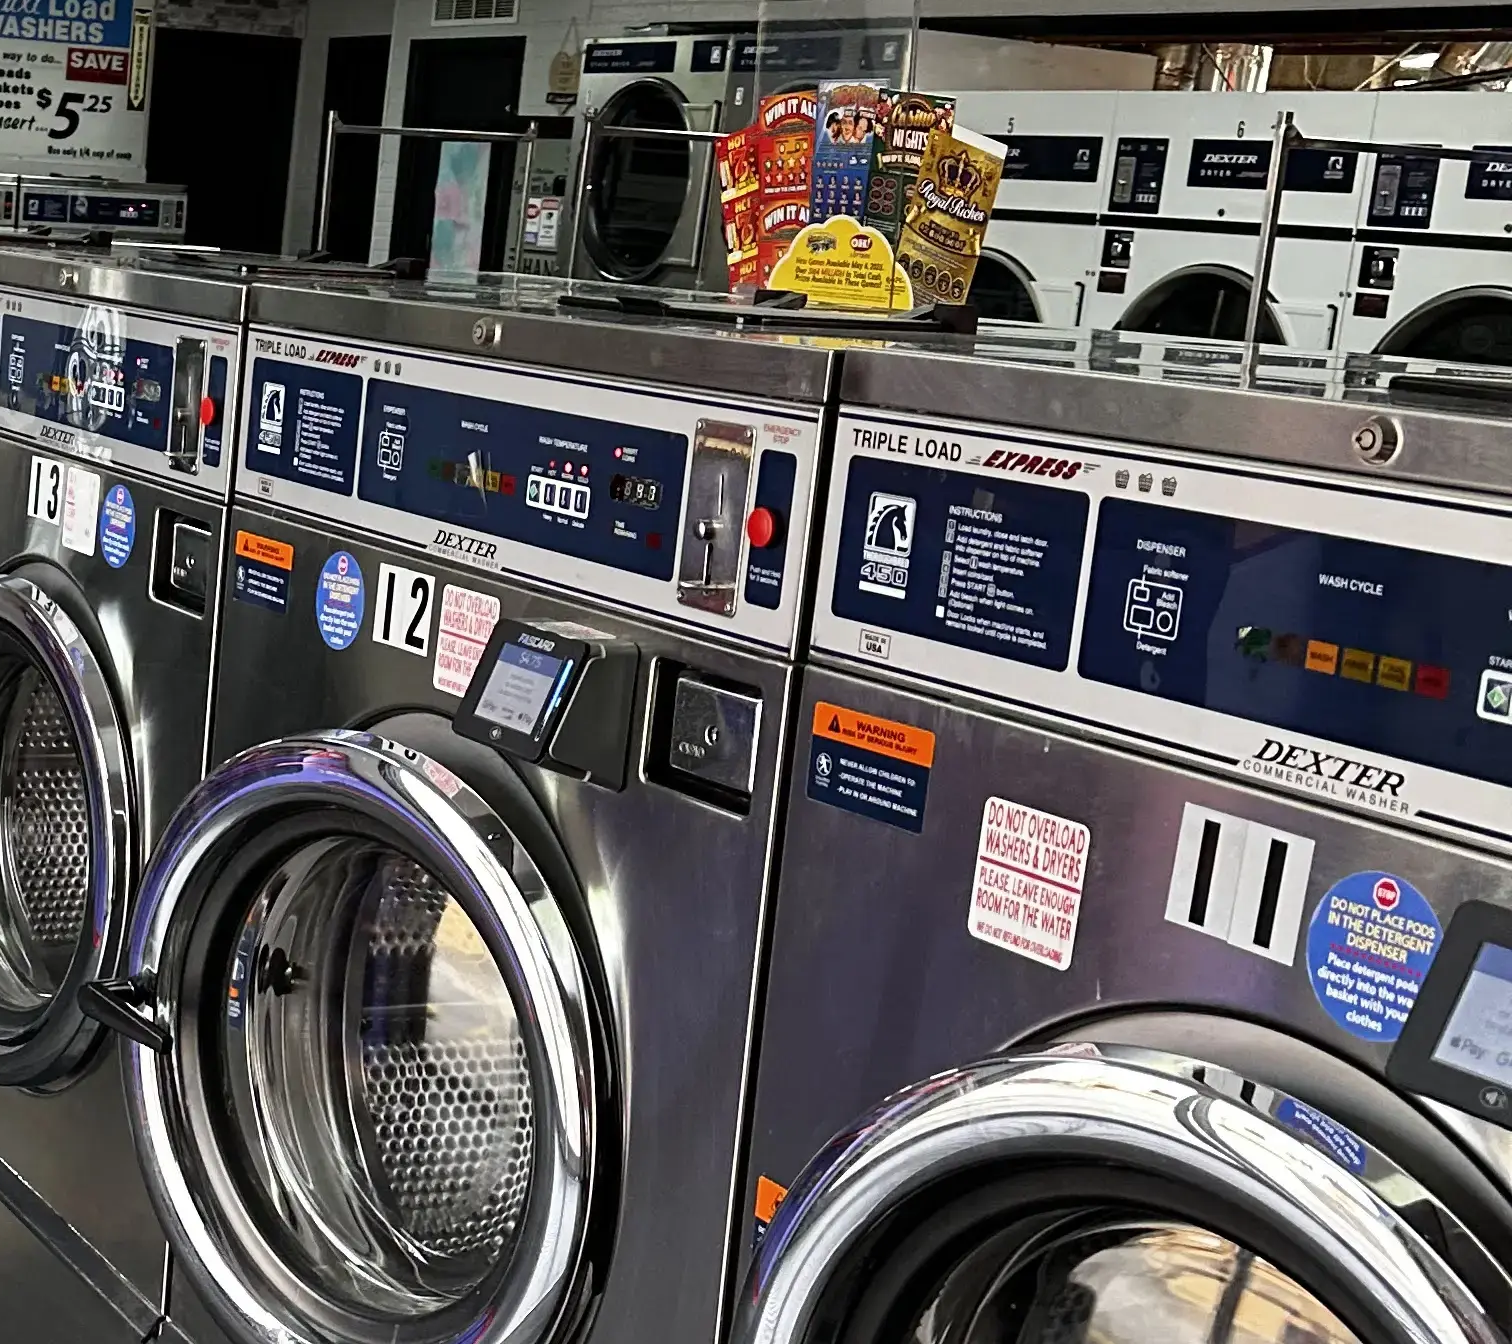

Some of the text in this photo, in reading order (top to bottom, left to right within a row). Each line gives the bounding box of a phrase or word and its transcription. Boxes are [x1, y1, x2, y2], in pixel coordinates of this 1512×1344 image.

[2, 51, 23, 64] way
[26, 51, 38, 62] to
[70, 51, 124, 72] SAVE
[765, 101, 786, 126] WIN
[787, 98, 799, 114] IT
[892, 103, 937, 126] Casino
[1007, 117, 1015, 134] 5
[1237, 120, 1246, 139] 6
[728, 134, 746, 150] HOT
[893, 129, 929, 151] NIGHTS
[1202, 153, 1259, 164] DEXTER
[735, 197, 752, 213] HOT
[919, 180, 986, 222] Royal Riches
[740, 260, 758, 276] HOT
[255, 338, 360, 369] TRIPLE LOAD EXPRESS
[40, 425, 76, 446] DEXTER
[853, 427, 1083, 480] TRIPLE LOAD EXPRESS
[34, 462, 60, 520] 13
[949, 505, 1004, 524] INSTRUCTIONS
[428, 542, 501, 571] COMMERCIAL WASHER
[432, 528, 498, 560] DEXTER
[1137, 539, 1186, 558] DISPENSER
[860, 561, 909, 588] 450
[1143, 564, 1168, 577] Fabric
[1161, 591, 1176, 601] Add
[1319, 572, 1384, 597] WASH CYCLE
[382, 572, 430, 650] 12
[1156, 599, 1178, 611] Bleach
[518, 632, 556, 652] FASCARD
[865, 642, 882, 654] USA
[1136, 640, 1167, 656] Detergent
[856, 720, 906, 743] WARNING
[1252, 737, 1406, 798] DEXTER
[1242, 757, 1410, 816] COMMERCIAL WASHER
[988, 801, 1086, 855] DO NOT OVERLOAD
[986, 828, 1082, 884] WASHERS & DRYERS
[1011, 876, 1039, 903] LEAVE
[1040, 885, 1077, 916] ENOUGH
[1188, 819, 1288, 950] 11
[1378, 887, 1397, 901] STOP
[977, 887, 1072, 941] ROOM FOR THE WATER
[1331, 896, 1436, 940] DO NOT PLACE PODS
[1328, 911, 1435, 956] IN THE DETERGENT
[1346, 932, 1408, 964] DISPENSER
[1328, 952, 1419, 994] Place detergent pods
[1317, 966, 1415, 1009] directly into the wa
[1326, 983, 1359, 1005] basket
[1360, 996, 1384, 1015] with
[1345, 1010, 1383, 1033] clothes
